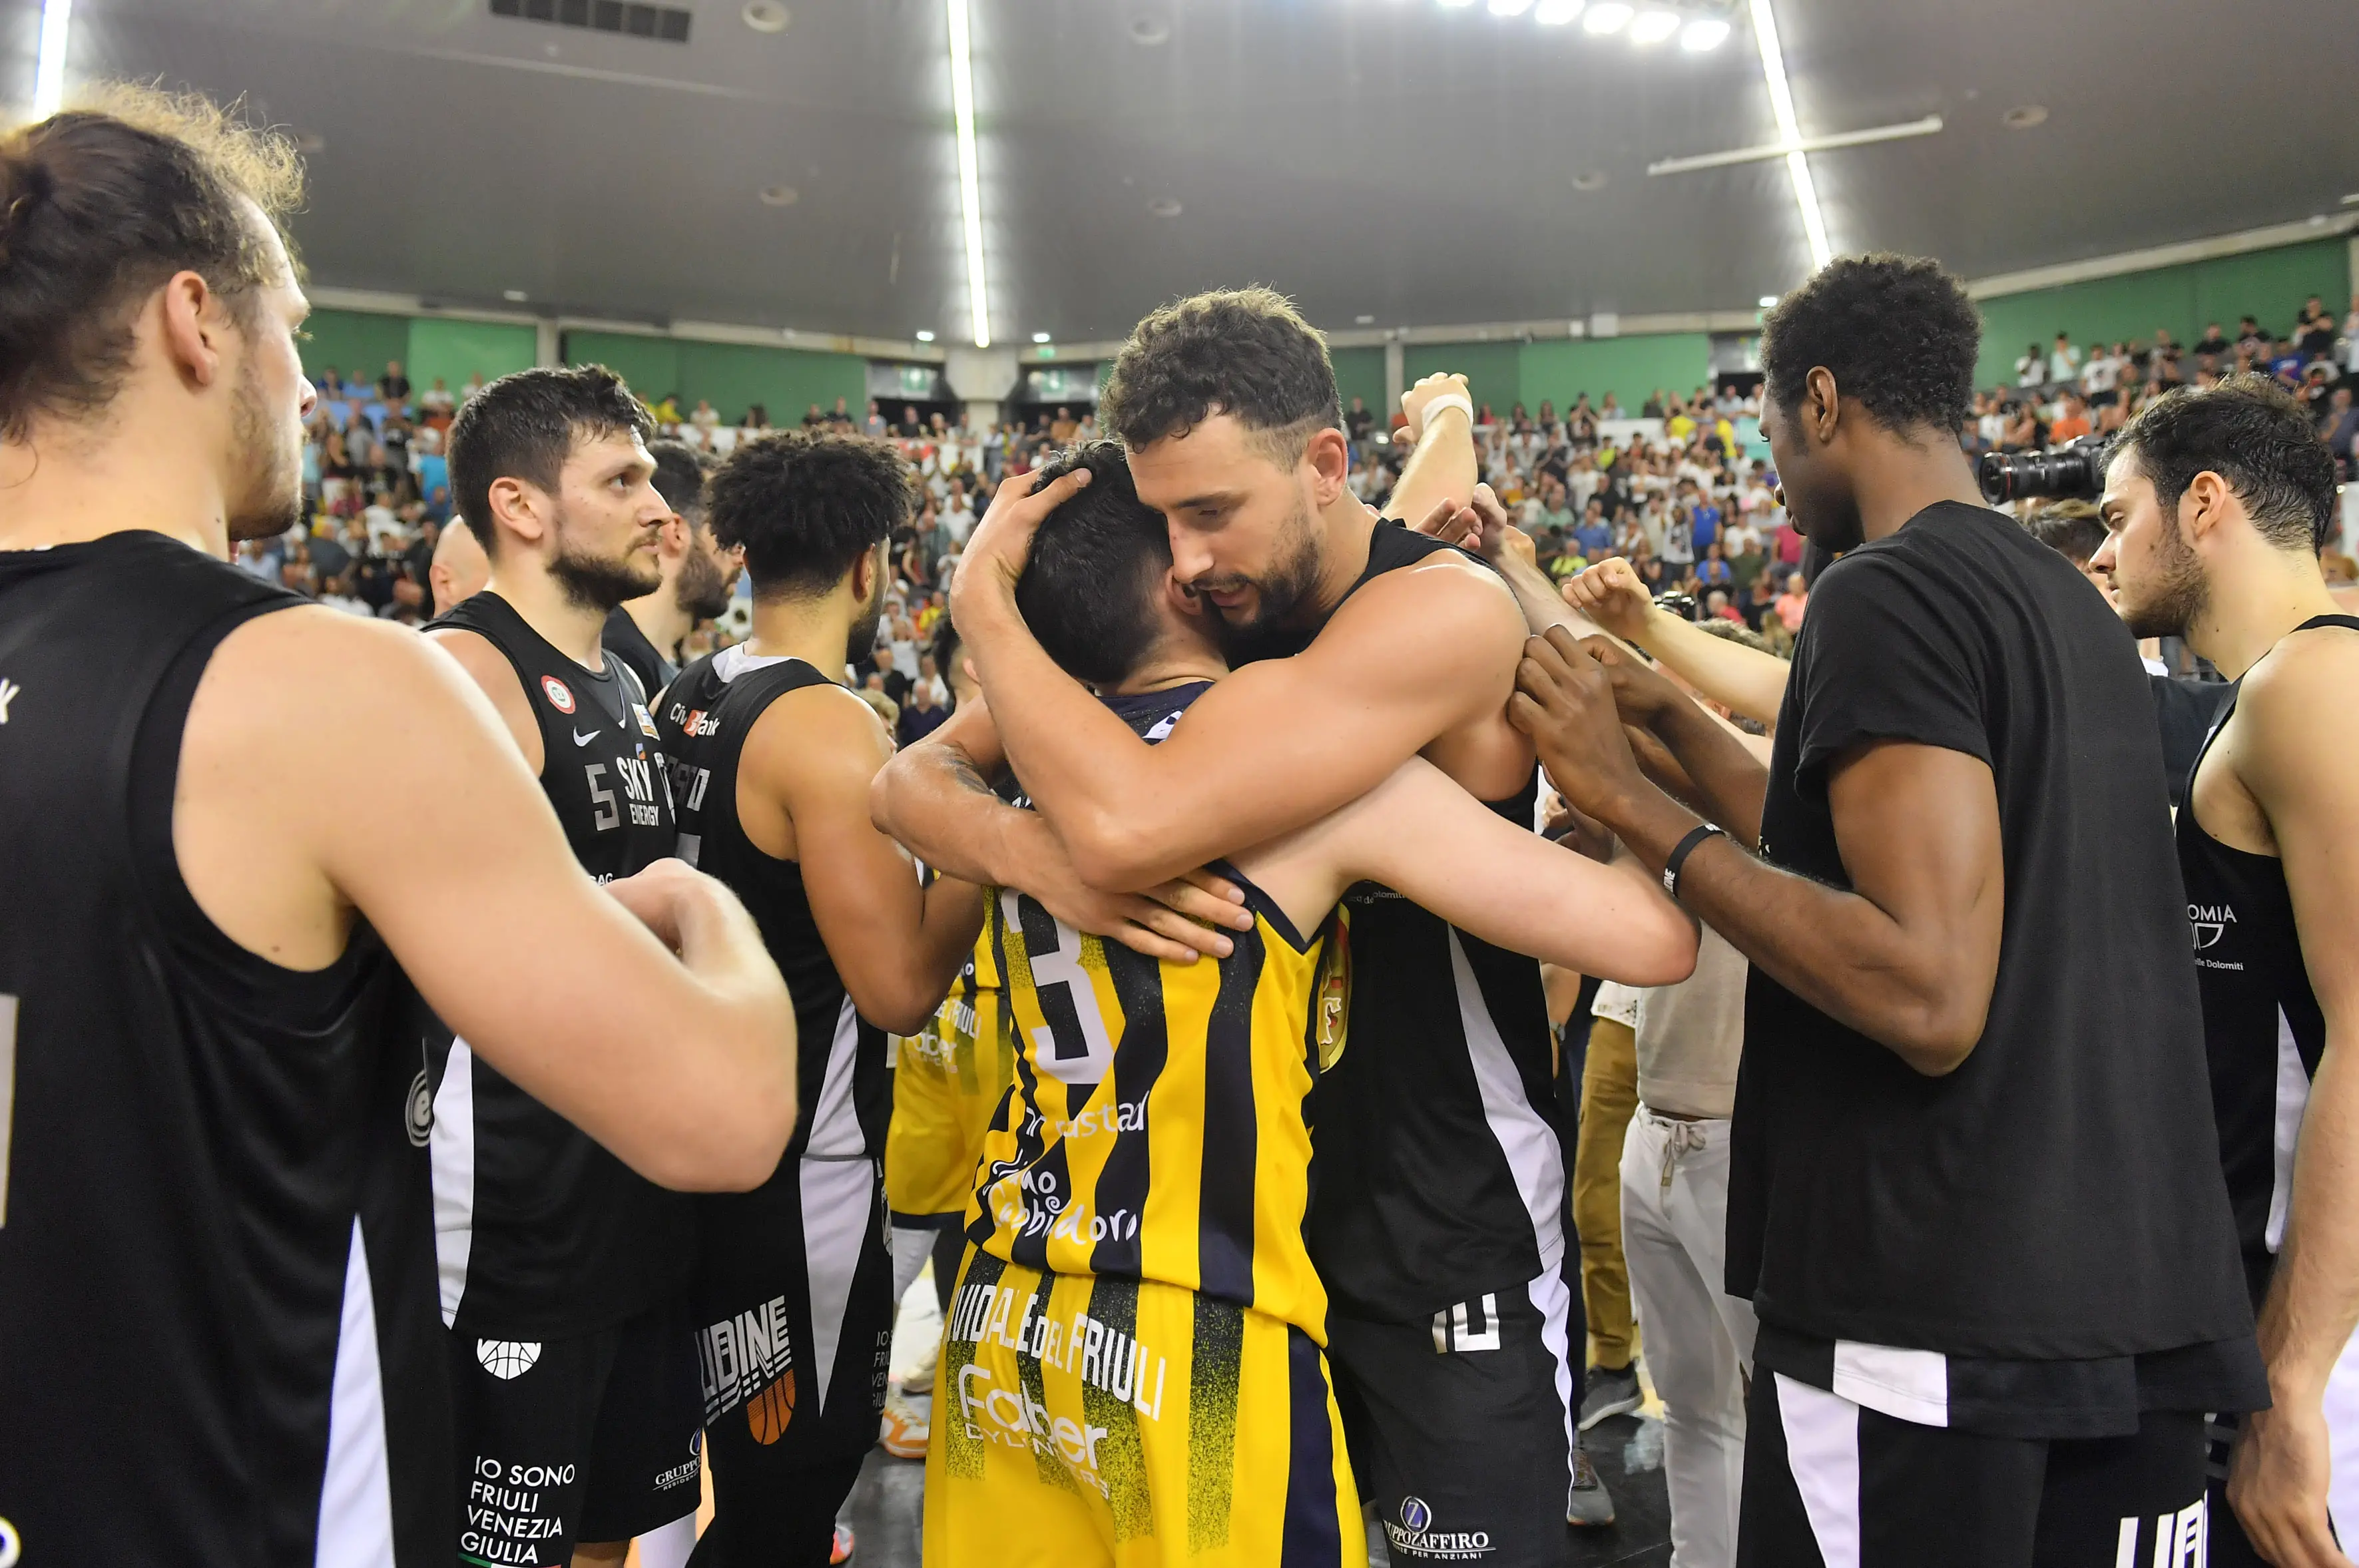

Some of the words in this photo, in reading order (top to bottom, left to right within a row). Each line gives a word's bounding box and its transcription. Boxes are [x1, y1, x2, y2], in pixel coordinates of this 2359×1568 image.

[617, 757, 654, 802] SKY
[585, 763, 620, 831] 5
[629, 803, 659, 826] ENERGY
[2187, 904, 2237, 923] OMIA
[2206, 959, 2244, 971] Dolomiti
[1001, 887, 1115, 1084] 3
[694, 1295, 792, 1418] UDINE
[1066, 1312, 1166, 1422] FRIULI
[958, 1363, 1107, 1470] Faber
[475, 1455, 501, 1479] IO
[509, 1463, 575, 1487] SONO
[655, 1456, 700, 1485] GRUPPO
[471, 1481, 539, 1513] FRIULI
[467, 1504, 563, 1539] VENEZIA
[461, 1531, 538, 1564] GIULIA
